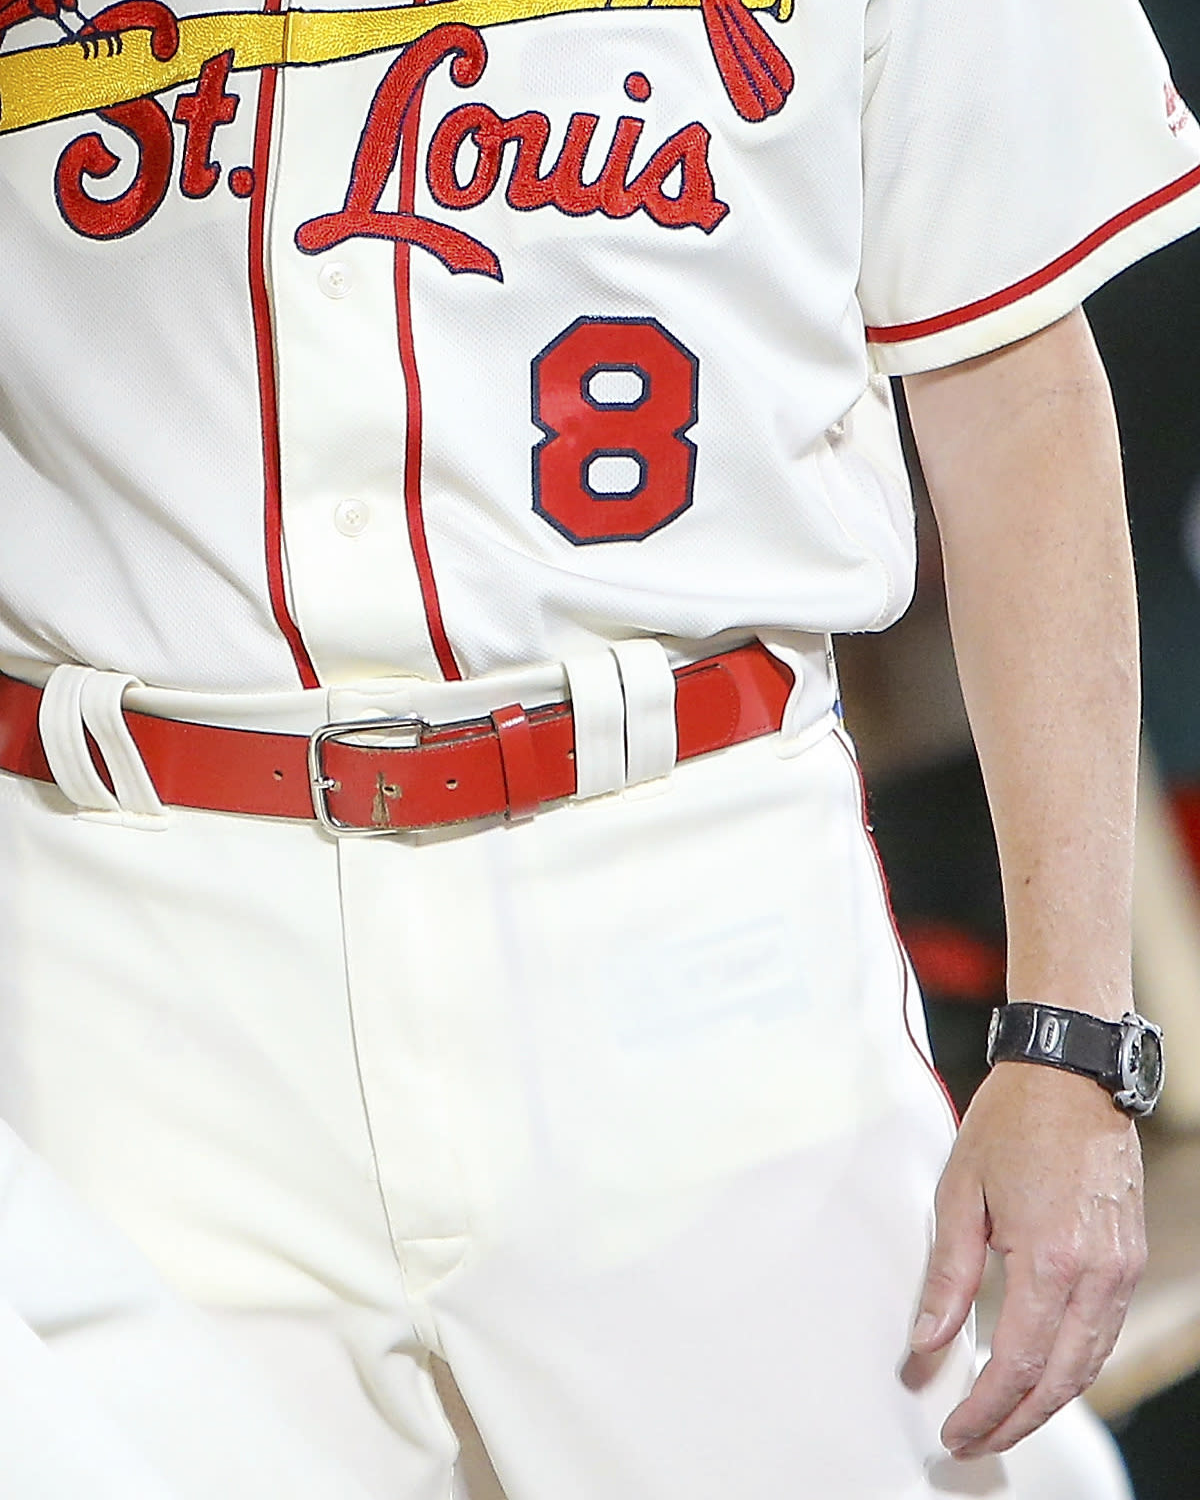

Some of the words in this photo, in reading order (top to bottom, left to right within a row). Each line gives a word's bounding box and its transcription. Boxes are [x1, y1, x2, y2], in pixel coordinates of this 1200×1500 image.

[54, 0, 255, 241] St.
[294, 23, 730, 284] Louis
[530, 315, 700, 547] 8
